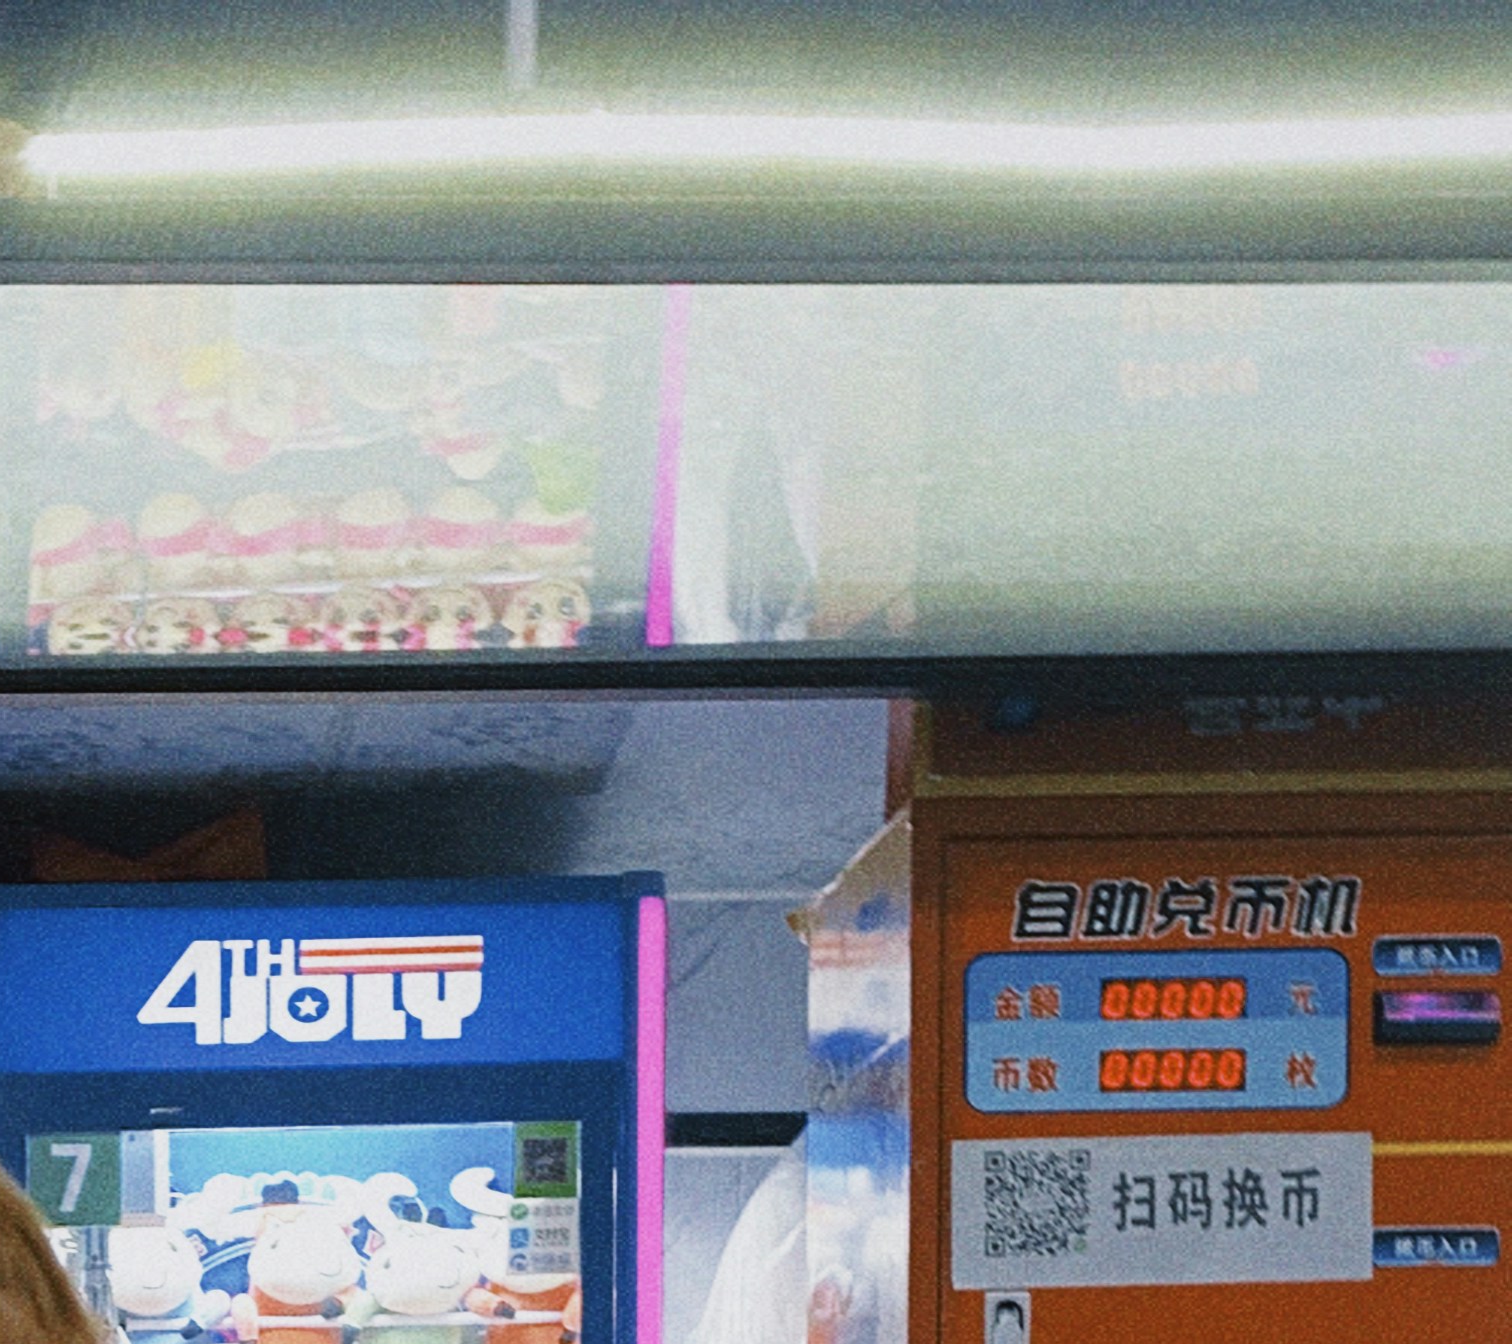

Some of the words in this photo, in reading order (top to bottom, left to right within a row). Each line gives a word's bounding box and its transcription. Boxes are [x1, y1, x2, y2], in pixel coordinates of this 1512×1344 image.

[1011, 876, 1361, 941] 自助兑币机
[993, 984, 1062, 1020] 金额
[1100, 979, 1245, 1020] 00000
[1291, 982, 1319, 1017] 元
[993, 1056, 1060, 1092] 币数
[1100, 1050, 1245, 1091] 00000
[1287, 1054, 1318, 1090] 枚
[50, 1143, 92, 1212] 7
[1112, 1167, 1322, 1233] 扫码换币
